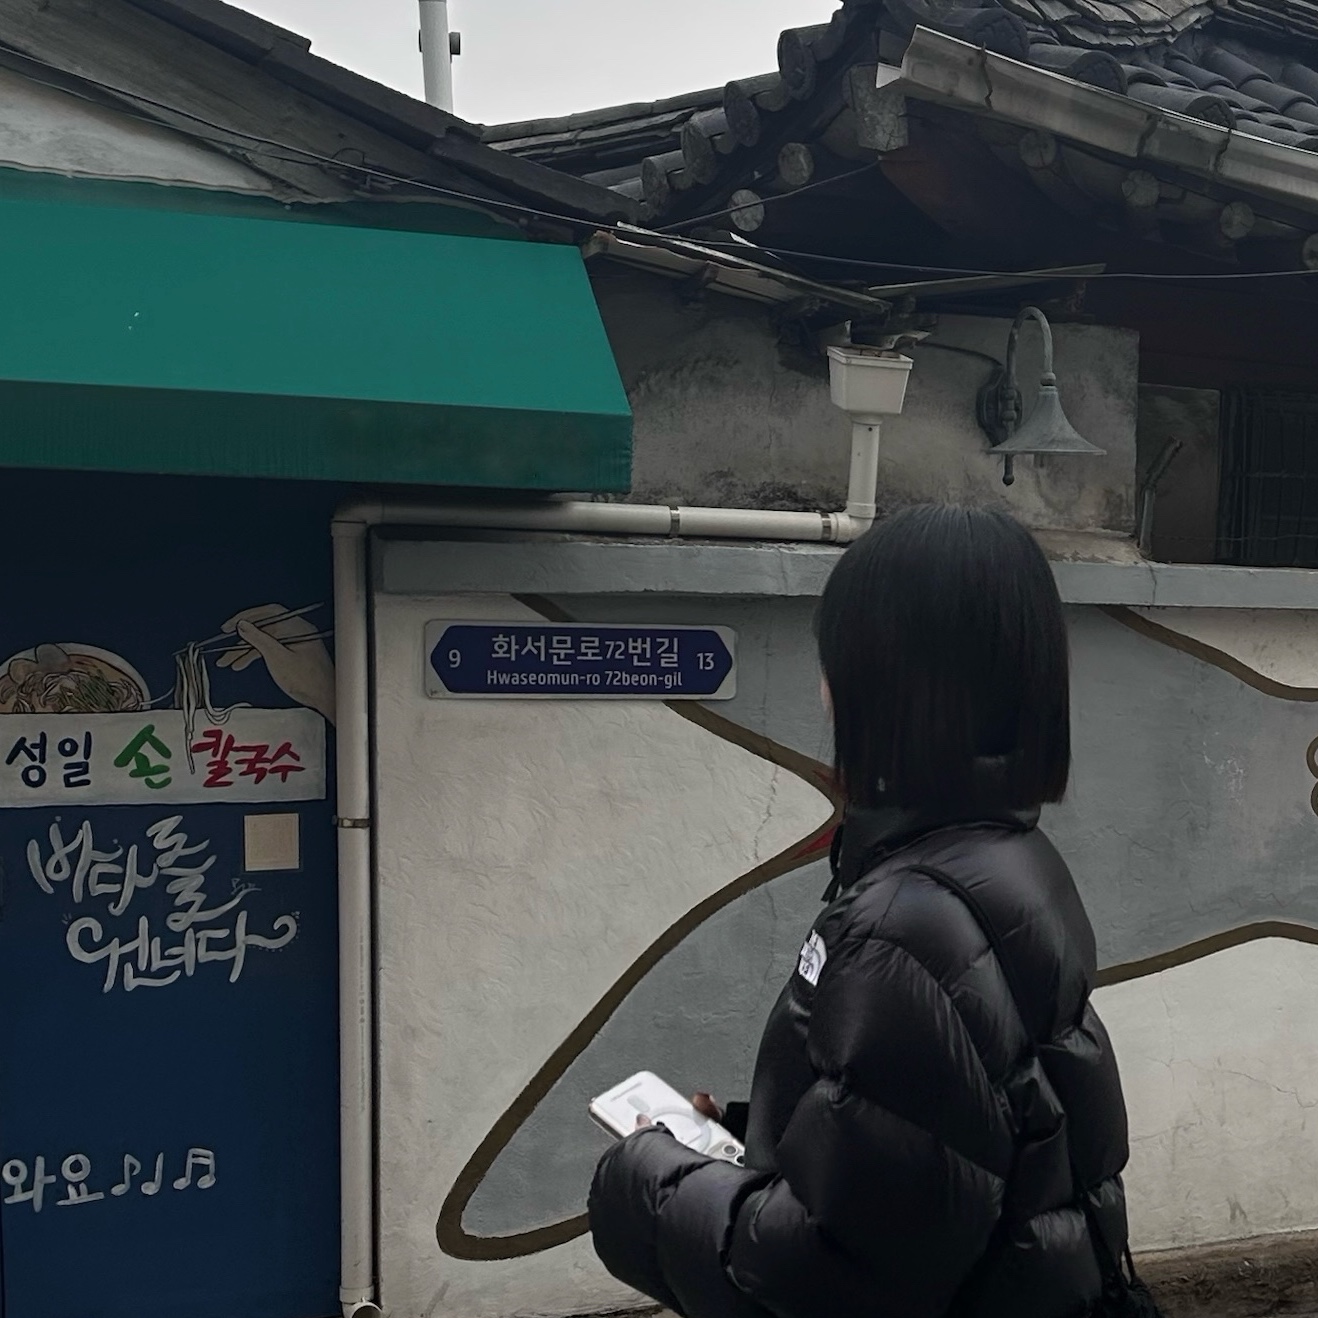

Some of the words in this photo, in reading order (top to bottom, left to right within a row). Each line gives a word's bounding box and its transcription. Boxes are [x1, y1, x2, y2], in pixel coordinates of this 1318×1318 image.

[448, 649, 462, 669] 9
[491, 634, 679, 668] 화서문로72번길
[696, 652, 715, 671] 13
[487, 669, 601, 687] Hwaseomun-ro
[604, 670, 683, 689] 72beon-gil
[5, 730, 93, 789] 성일
[113, 723, 173, 790] 손
[192, 728, 306, 788] 칼국수
[27, 815, 261, 933] 바다를
[1, 1152, 105, 1213] 와요
